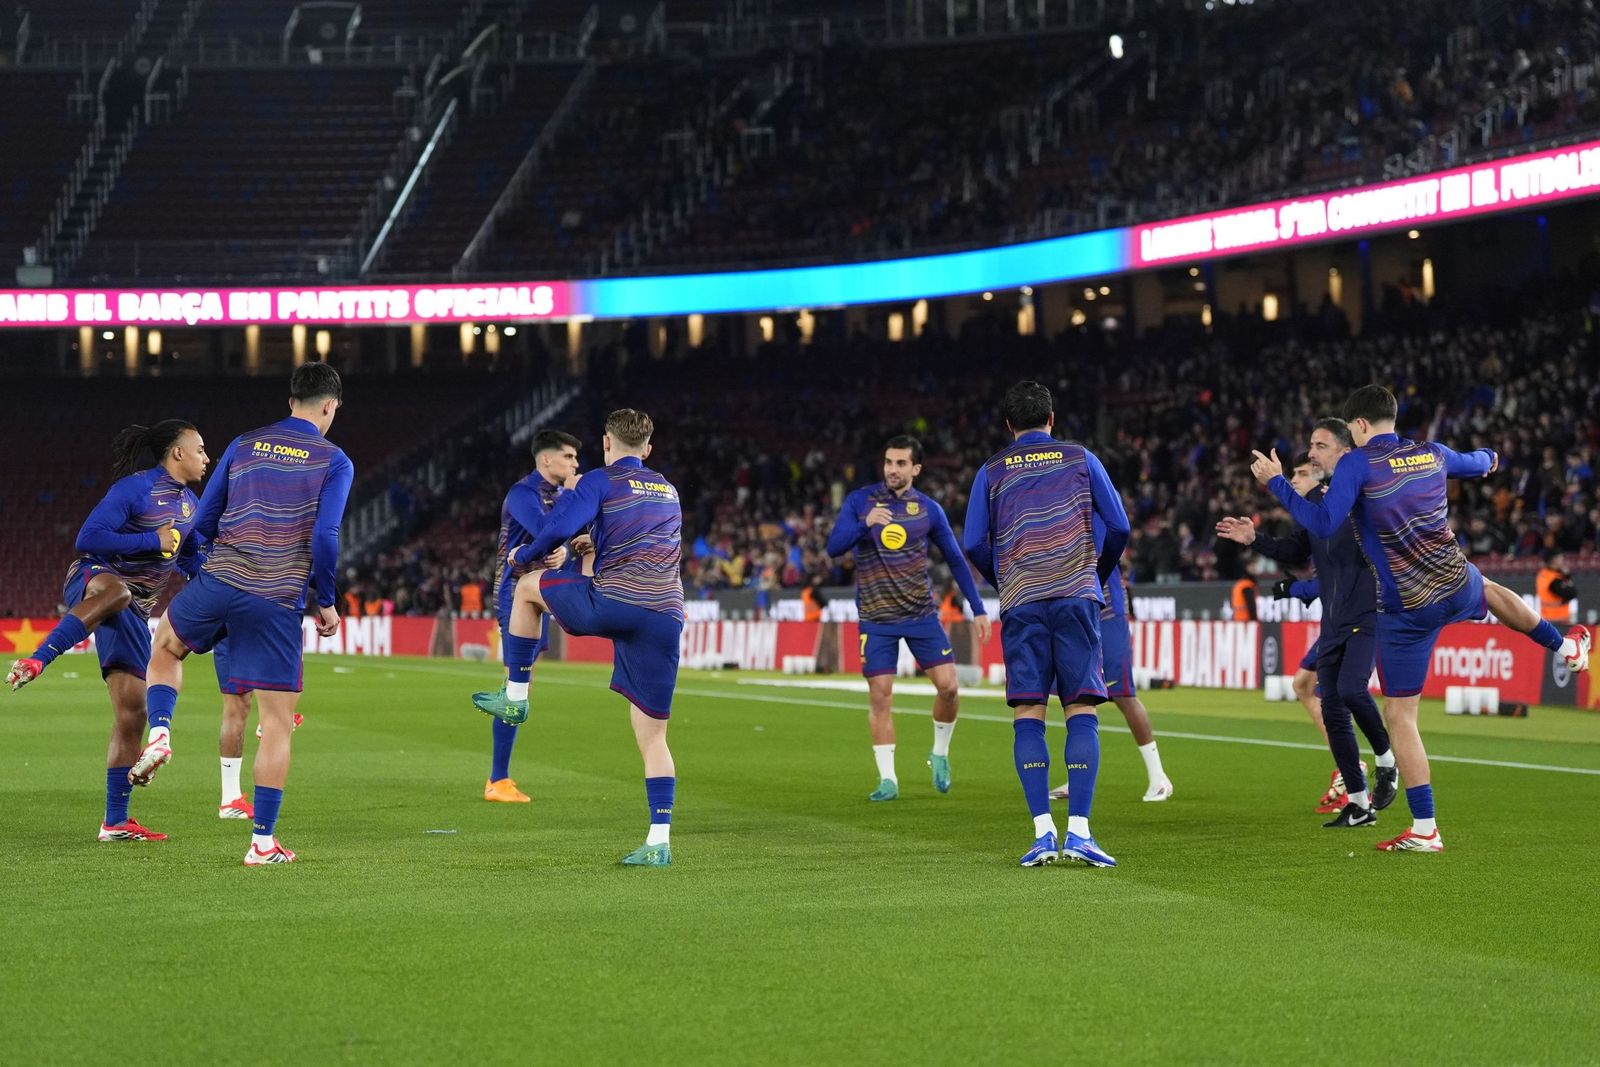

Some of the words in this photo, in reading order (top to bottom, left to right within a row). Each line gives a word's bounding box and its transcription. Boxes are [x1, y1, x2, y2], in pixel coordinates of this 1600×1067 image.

[0, 293, 68, 321] AMB
[75, 293, 112, 321] EL
[118, 292, 223, 325] BARÇA
[229, 291, 271, 320] EN
[277, 290, 409, 319] PARTITS
[414, 286, 553, 318] OFICIALS
[254, 442, 271, 452] R.D.
[273, 445, 309, 458] CONGO
[1005, 456, 1023, 465] R.D.
[1025, 452, 1063, 462] CONGO
[1389, 458, 1406, 467] R.D.
[1406, 453, 1434, 465] CONGO
[1180, 620, 1258, 689] DAMM
[1434, 638, 1514, 685] mapfre
